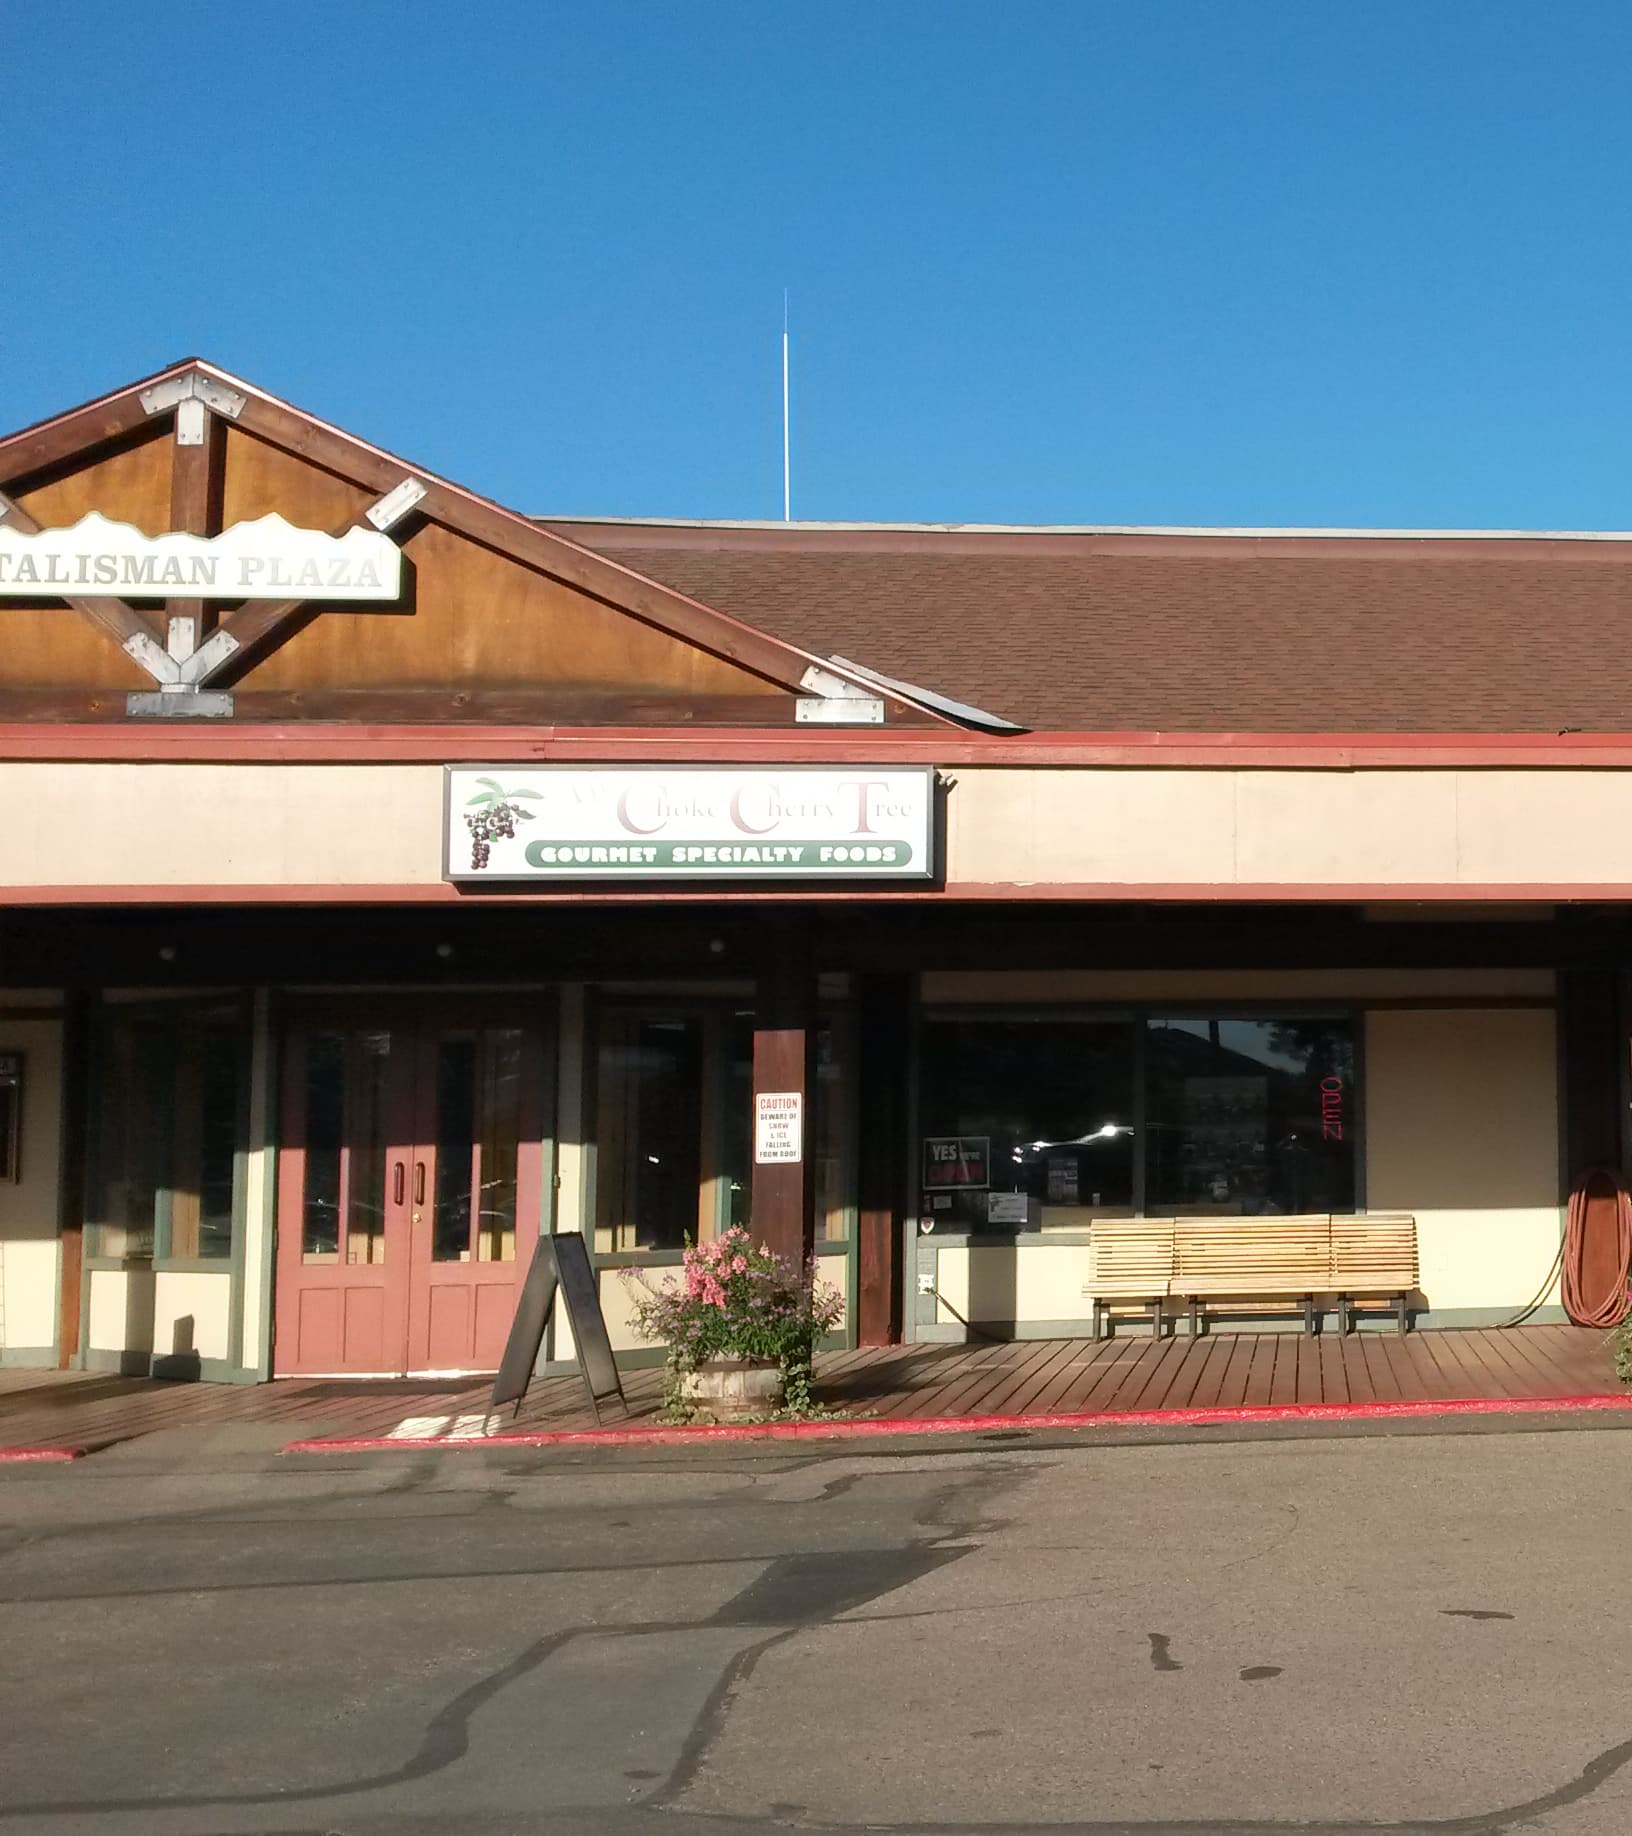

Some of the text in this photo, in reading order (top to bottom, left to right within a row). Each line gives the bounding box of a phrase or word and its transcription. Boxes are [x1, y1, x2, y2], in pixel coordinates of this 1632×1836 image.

[237, 556, 382, 588] PLAZA
[836, 780, 912, 834] Tree
[540, 846, 897, 863] GOURMET SPECIALTY FOODS
[760, 1098, 798, 1110] CAUTION
[1319, 1076, 1343, 1141] OPEN
[932, 1144, 957, 1161] YES
